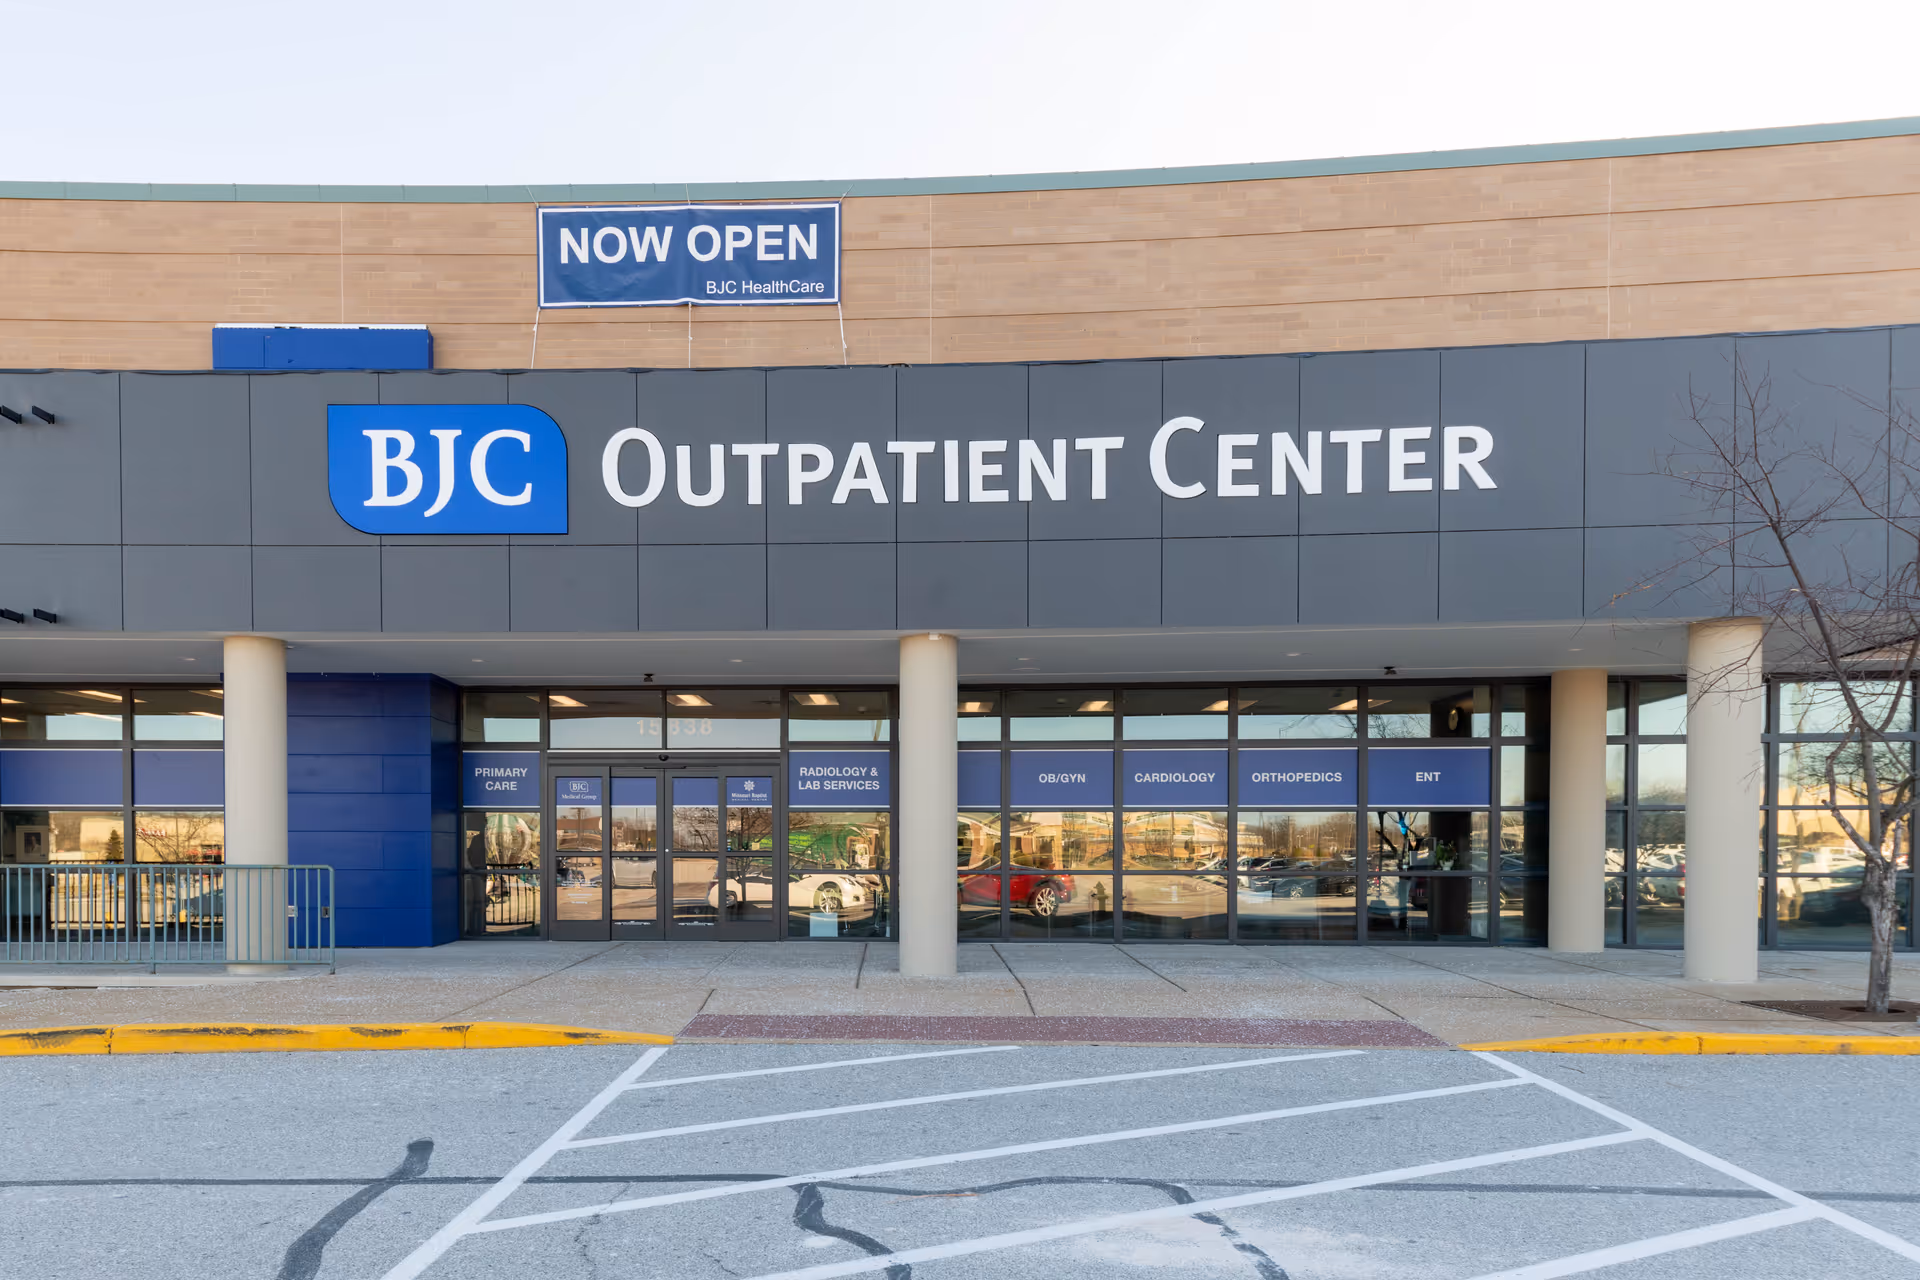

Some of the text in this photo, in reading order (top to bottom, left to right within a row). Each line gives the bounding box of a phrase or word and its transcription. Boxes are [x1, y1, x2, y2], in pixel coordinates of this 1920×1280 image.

[559, 223, 818, 264] NOW OPEN
[706, 279, 825, 295] BJC HealthCare
[362, 428, 533, 518] BJC
[474, 767, 528, 778] PRIMARY
[799, 767, 879, 777] RADIOLOGY &
[1134, 772, 1216, 783] CARDIOLOGY
[1251, 772, 1343, 783] ORTHOPEDICS
[1415, 772, 1441, 782] ENT
[1038, 773, 1086, 784] OB/GYN
[485, 781, 518, 791] CARE
[572, 783, 587, 791] BJC
[798, 780, 880, 791] LAB SERVICES
